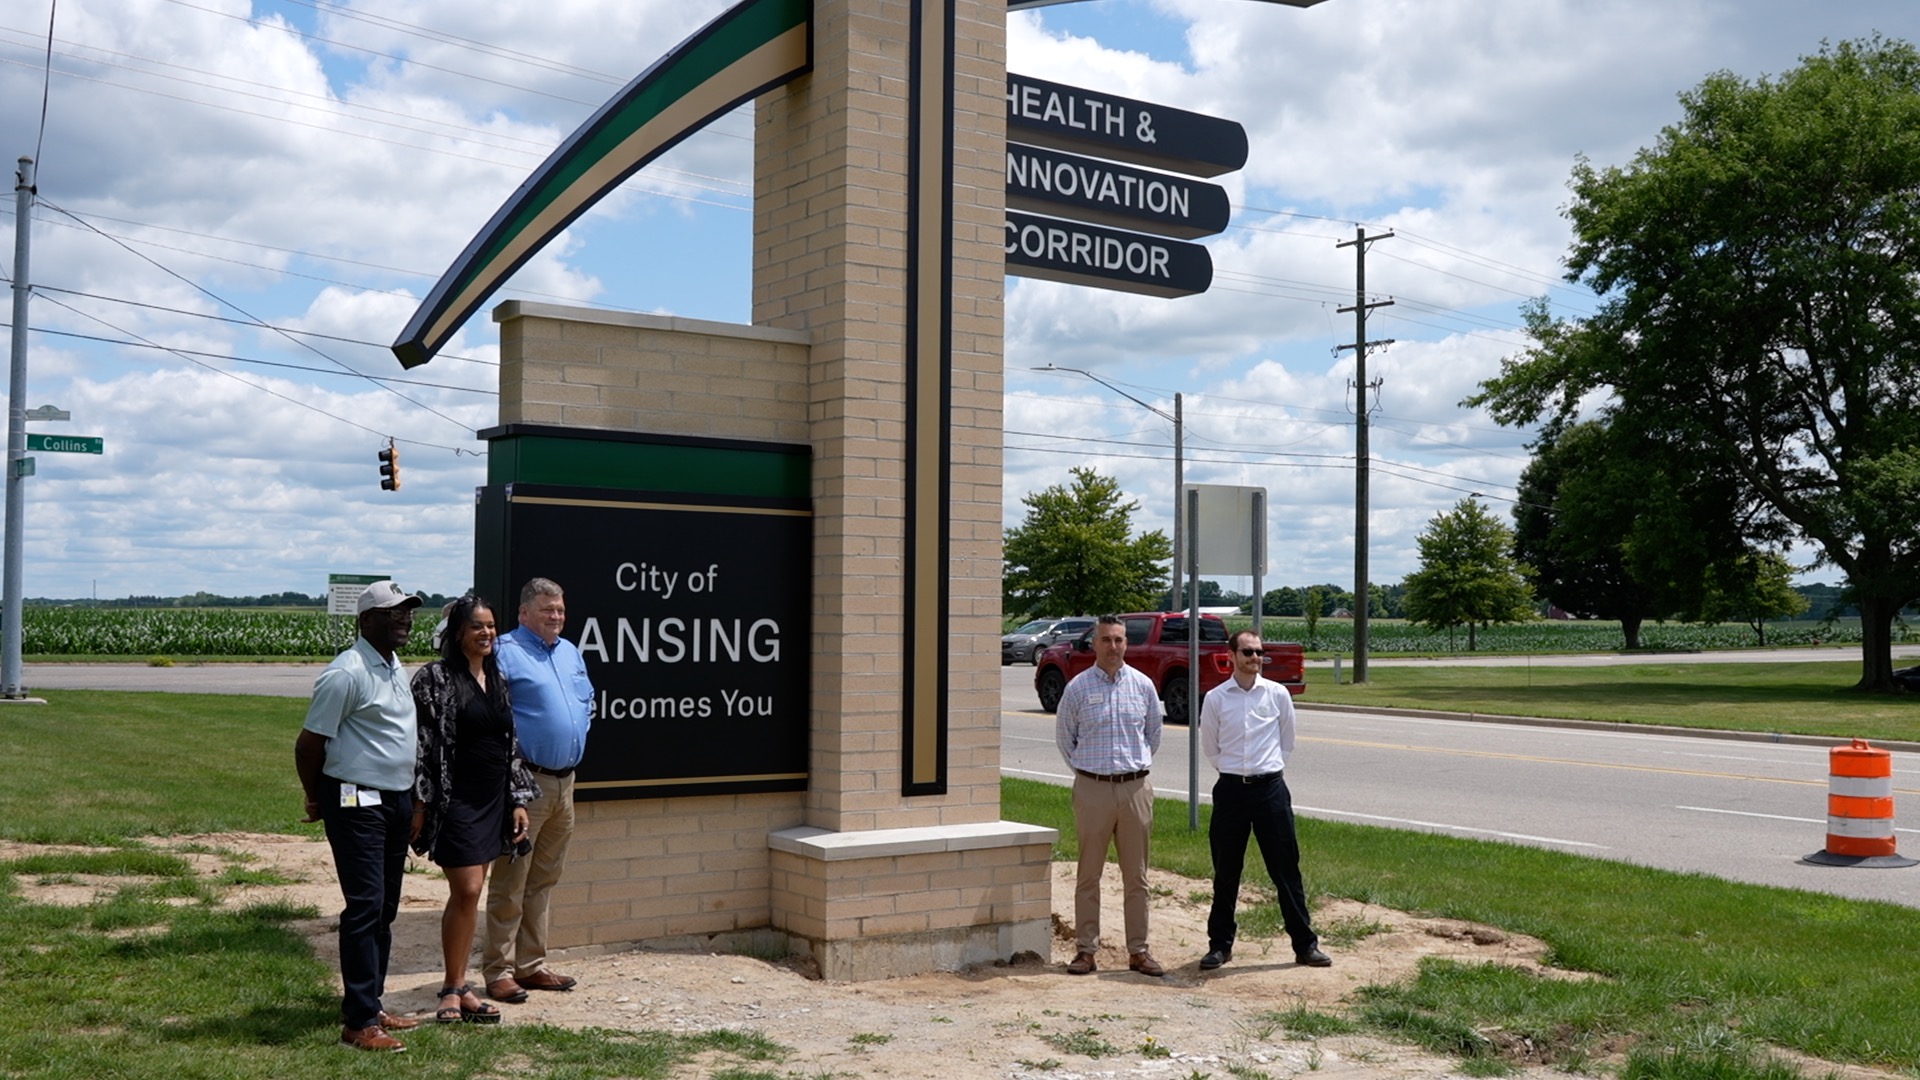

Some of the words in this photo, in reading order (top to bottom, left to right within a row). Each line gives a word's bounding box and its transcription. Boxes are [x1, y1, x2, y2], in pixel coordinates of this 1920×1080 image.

[1006, 83, 1125, 137] HEALTH
[1136, 111, 1156, 143] &
[1007, 152, 1189, 217] NNOVATION
[1005, 221, 1170, 278] CORRIDOR
[43, 437, 88, 452] Collins
[616, 562, 678, 599] City
[687, 564, 718, 592] of
[577, 617, 780, 663] ANSING
[589, 690, 711, 719] elcomes
[721, 690, 772, 716] You
